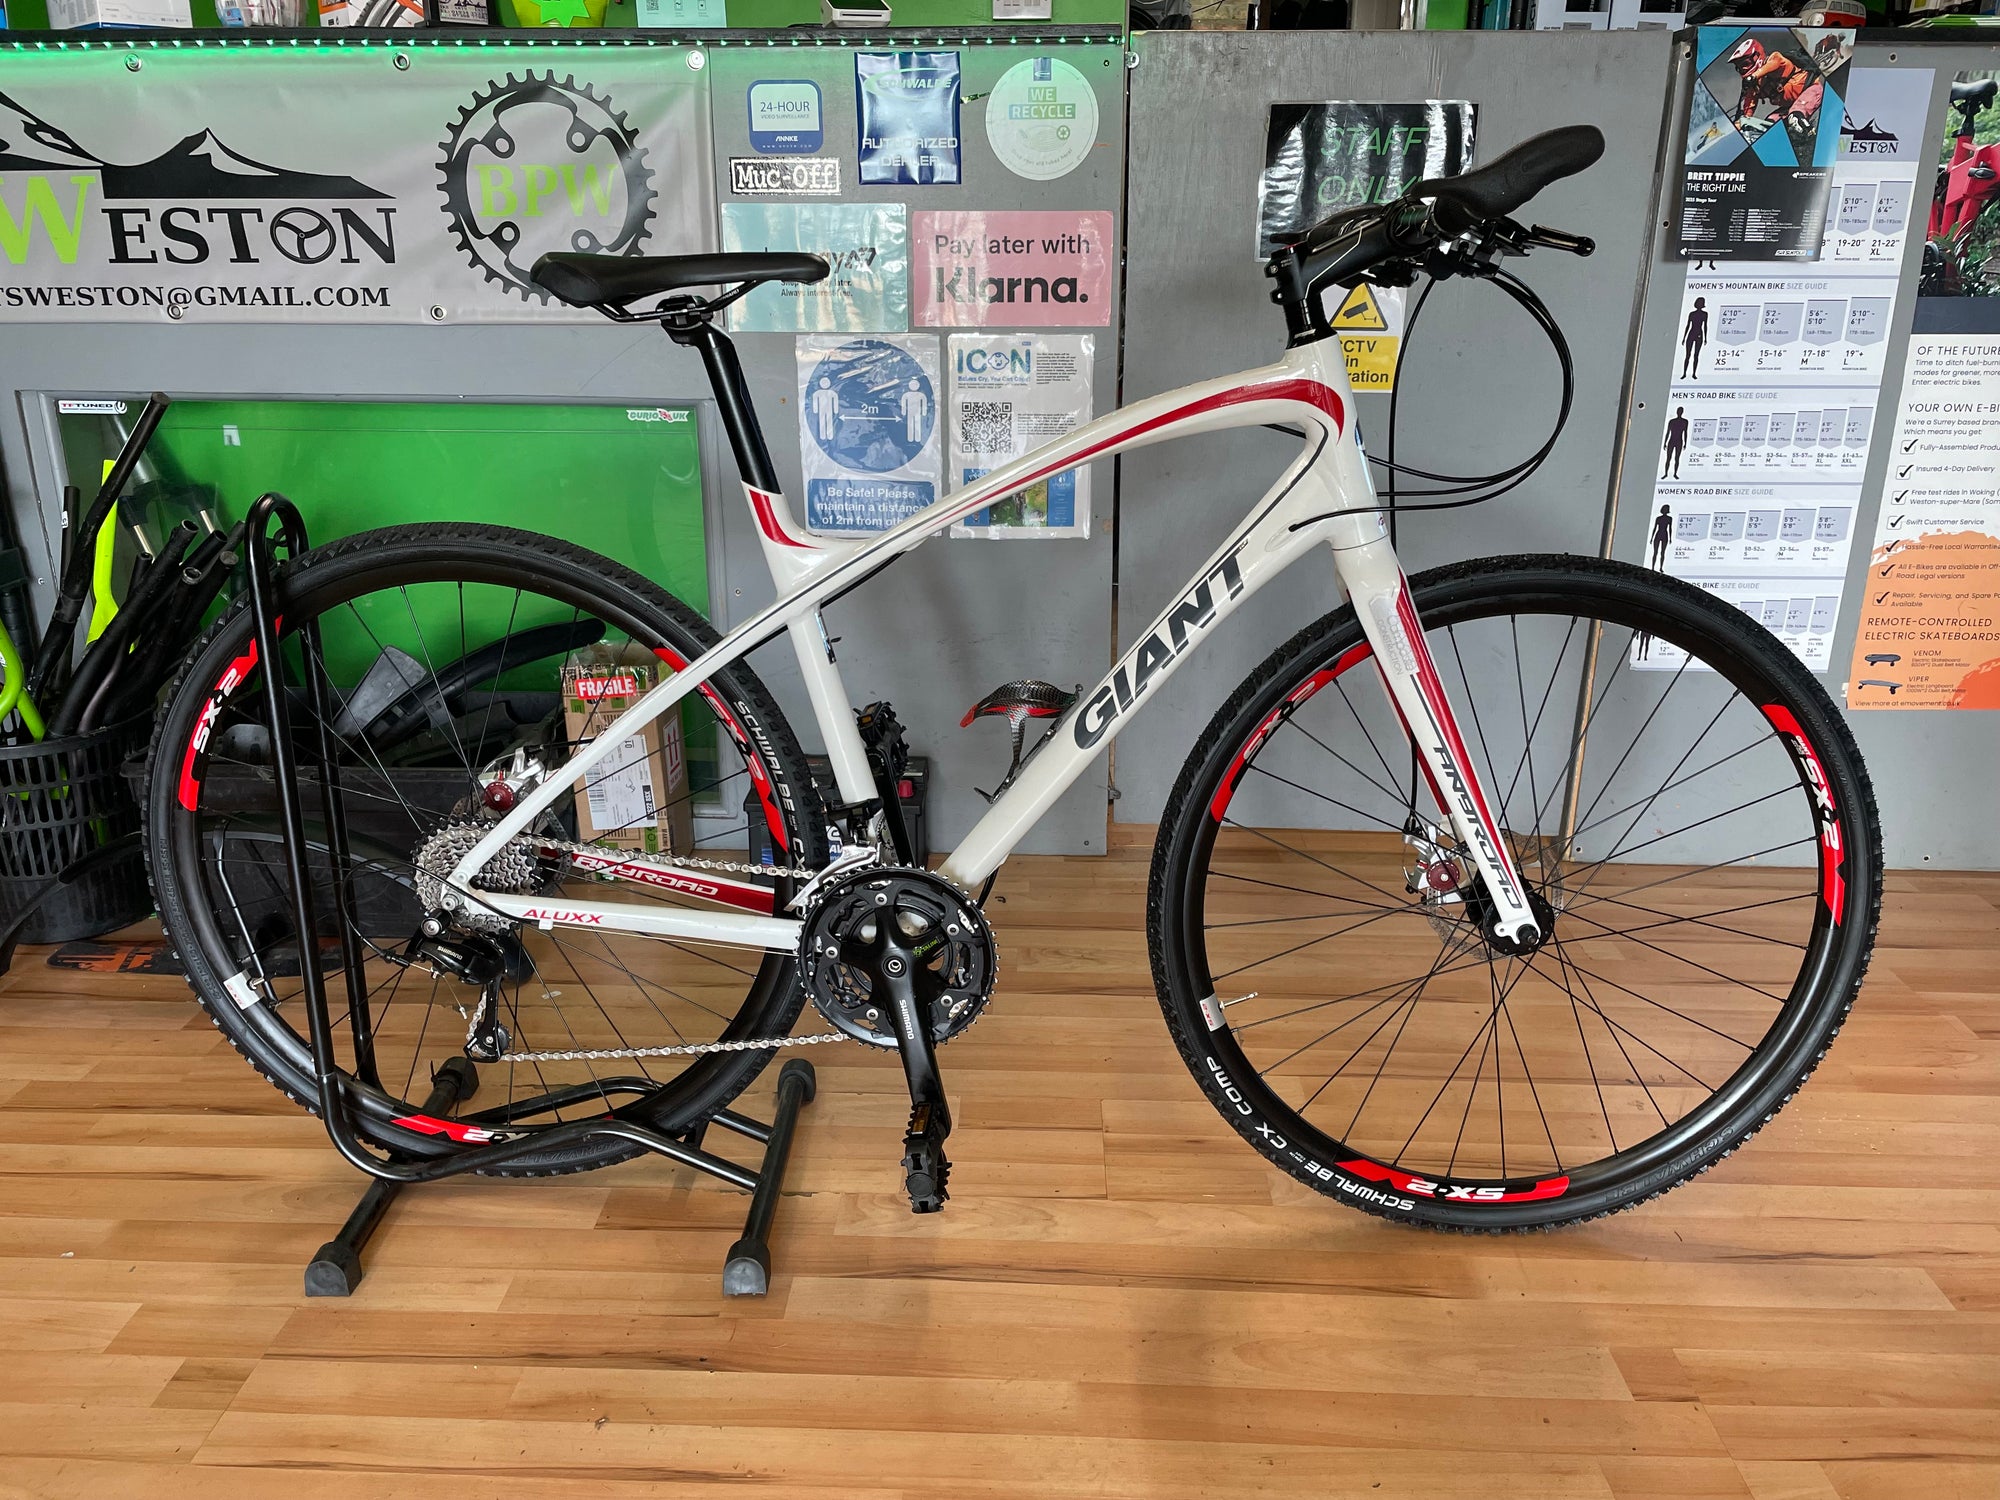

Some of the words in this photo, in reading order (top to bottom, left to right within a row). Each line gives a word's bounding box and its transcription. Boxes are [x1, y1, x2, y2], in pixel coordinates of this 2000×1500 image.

[1031, 88, 1054, 101] WE
[760, 101, 810, 112] 24-HOUR
[1013, 105, 1073, 118] RECYCLE
[1321, 127, 1429, 156] STAFF
[737, 164, 834, 189] Muc-Off
[1687, 171, 1714, 181] BRETT
[1714, 172, 1746, 182] TIPPIE
[474, 164, 619, 218] BPW
[1317, 176, 1423, 204] ONLY
[1686, 183, 1701, 192] THE
[1701, 183, 1726, 193] RIGHT
[1727, 184, 1747, 193] LINE
[935, 234, 975, 259] Pay
[984, 234, 1034, 255] later
[1043, 234, 1090, 255] with
[1835, 248, 1841, 256] L
[1870, 248, 1881, 256] XL
[936, 266, 1089, 304] Klarna.
[781, 289, 806, 298] Always
[1339, 340, 1377, 353] CTV
[1917, 346, 1934, 356] OF
[1937, 346, 1959, 356] THE
[1345, 355, 1359, 367] in
[1715, 358, 1727, 366] XS
[1757, 358, 1764, 366] S
[1801, 358, 1809, 366] M
[1843, 358, 1849, 366] L
[1952, 369, 1982, 378] greener,
[861, 404, 879, 414] 2m
[1908, 403, 1940, 413] YOUR
[1943, 403, 1973, 413] OWN
[629, 411, 659, 420] CURIO
[672, 412, 686, 420] UK
[1933, 419, 1956, 428] Surrey
[1919, 444, 1979, 452] Fully-Assembled
[1944, 465, 1965, 473] 4-Day
[1966, 465, 1995, 473] Delivery
[827, 487, 842, 498] Be
[845, 487, 875, 499] Safe!
[877, 487, 916, 499] Please
[1969, 489, 1995, 497] Woking
[816, 502, 865, 512] maintain
[867, 503, 875, 512] a
[877, 502, 925, 513] distance
[1909, 498, 1981, 507] Weston-super-Mare
[822, 516, 834, 526] of
[835, 516, 851, 527] 2m
[853, 516, 883, 527] from
[1916, 573, 1936, 581] Legal
[1971, 592, 1992, 600] Spare
[1867, 617, 1993, 627] REMOTE-CONTROLLED
[1864, 631, 1917, 641] ELECTRIC
[1919, 631, 2000, 641] SKATEBOARDS
[1073, 547, 1245, 750] GIANT
[578, 678, 634, 698] FRAGILE
[192, 668, 242, 754] SX-2
[733, 700, 796, 812] SCHWALBE
[793, 838, 806, 872] CX
[1799, 757, 1841, 851] SX-2
[522, 908, 603, 925] ALUXX
[437, 945, 464, 961] SHIMANO
[899, 998, 915, 1040] SHIMANO
[1206, 1055, 1253, 1116] COMP
[1254, 1121, 1288, 1150] CX
[1303, 1160, 1416, 1211] SCHWALBE
[1406, 1178, 1506, 1201] SX-2
